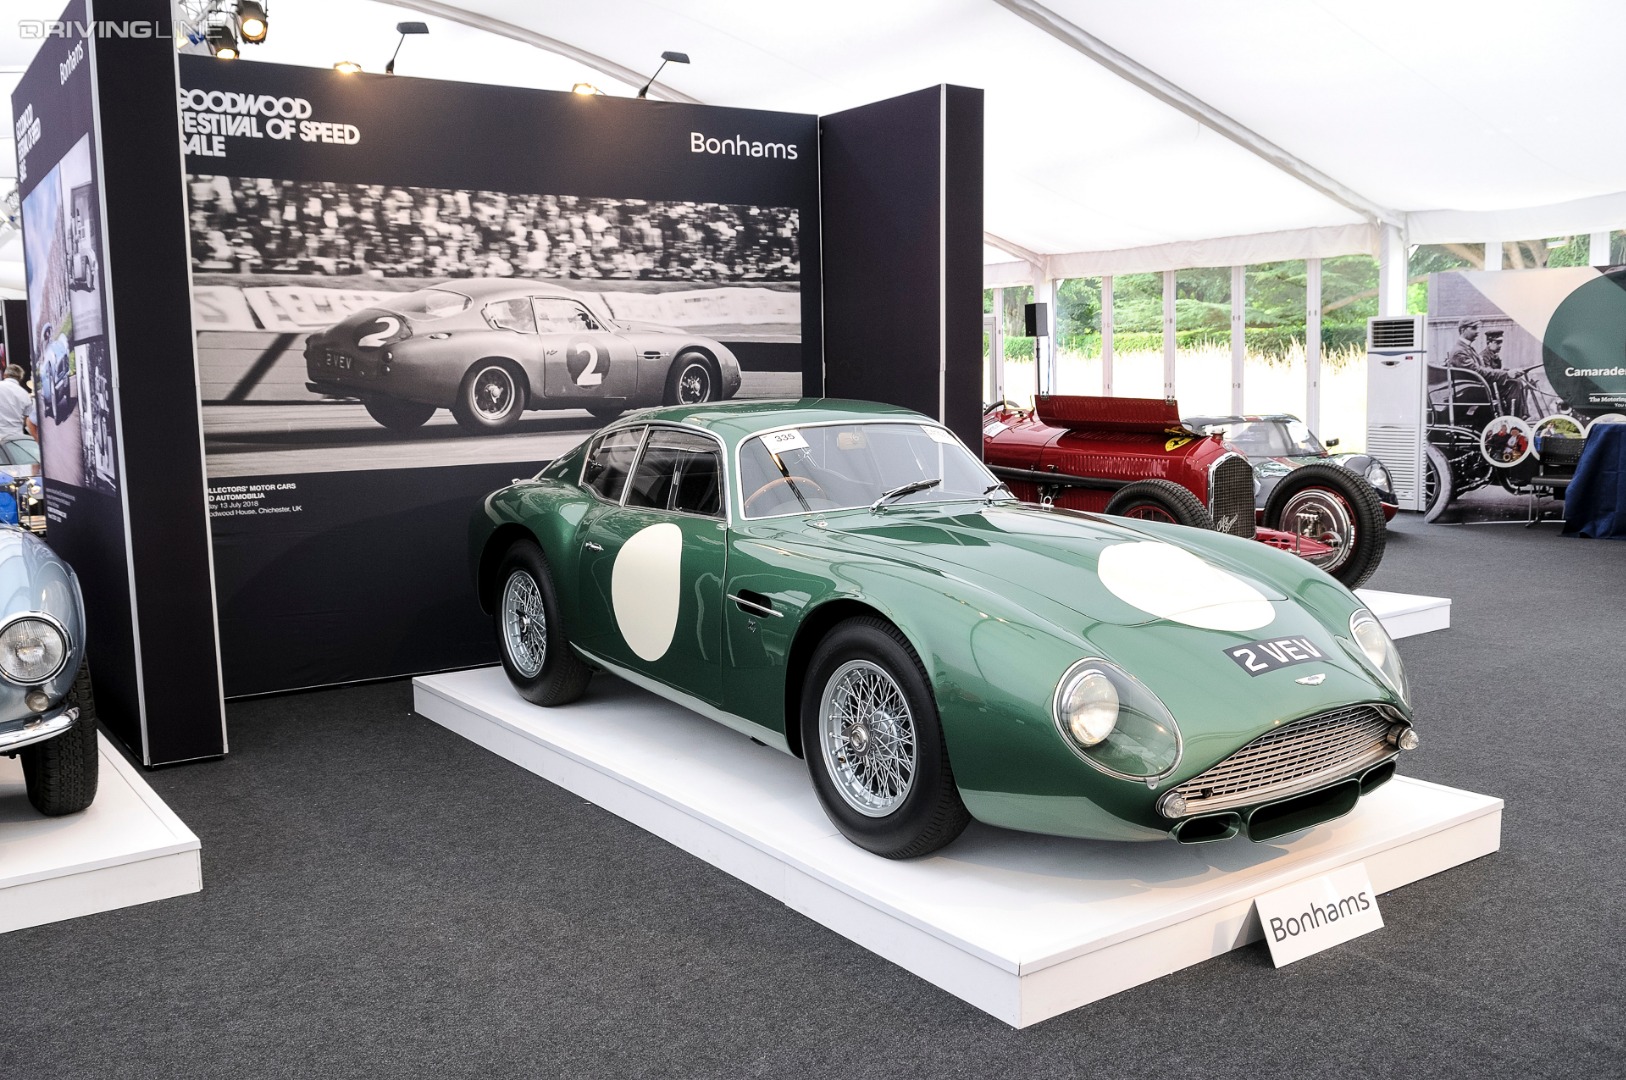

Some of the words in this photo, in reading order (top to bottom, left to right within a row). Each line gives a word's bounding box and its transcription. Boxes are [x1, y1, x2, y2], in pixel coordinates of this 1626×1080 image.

[60, 40, 84, 86] Bonhams
[182, 111, 264, 139] ESTIVAL
[265, 118, 297, 141] OF
[299, 121, 361, 145] SPEED
[690, 131, 799, 160] Bonhams
[358, 316, 400, 348] 2
[576, 342, 603, 386] 2
[774, 433, 796, 442] 335
[216, 492, 265, 501] AUTOMOBILIA
[249, 484, 276, 492] MOTOR
[229, 501, 242, 509] July
[1233, 648, 1269, 672] 2
[1257, 638, 1322, 663] VEV
[1269, 891, 1370, 943] Bonhams
